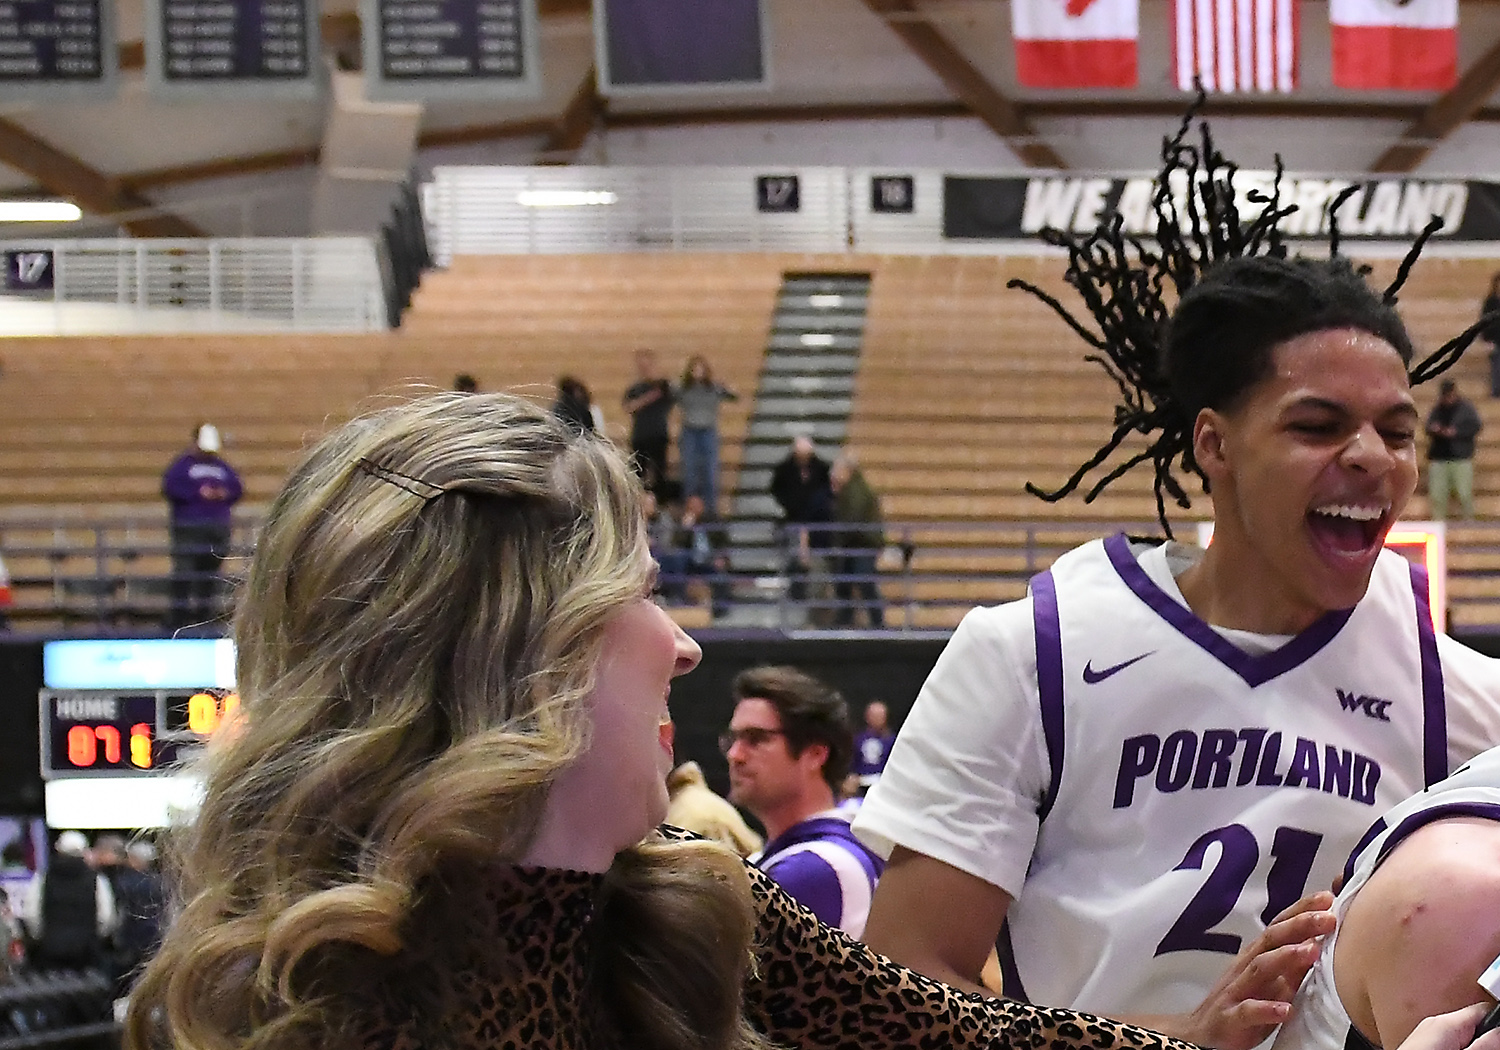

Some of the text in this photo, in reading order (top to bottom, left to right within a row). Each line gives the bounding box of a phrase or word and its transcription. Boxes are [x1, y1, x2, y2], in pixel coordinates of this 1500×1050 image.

[1021, 178, 1112, 234] WE
[16, 252, 48, 283] 17
[56, 699, 121, 721] HOME
[1335, 687, 1393, 722] WCC
[1112, 725, 1383, 809] PORTLAND
[1152, 822, 1324, 959] 21
